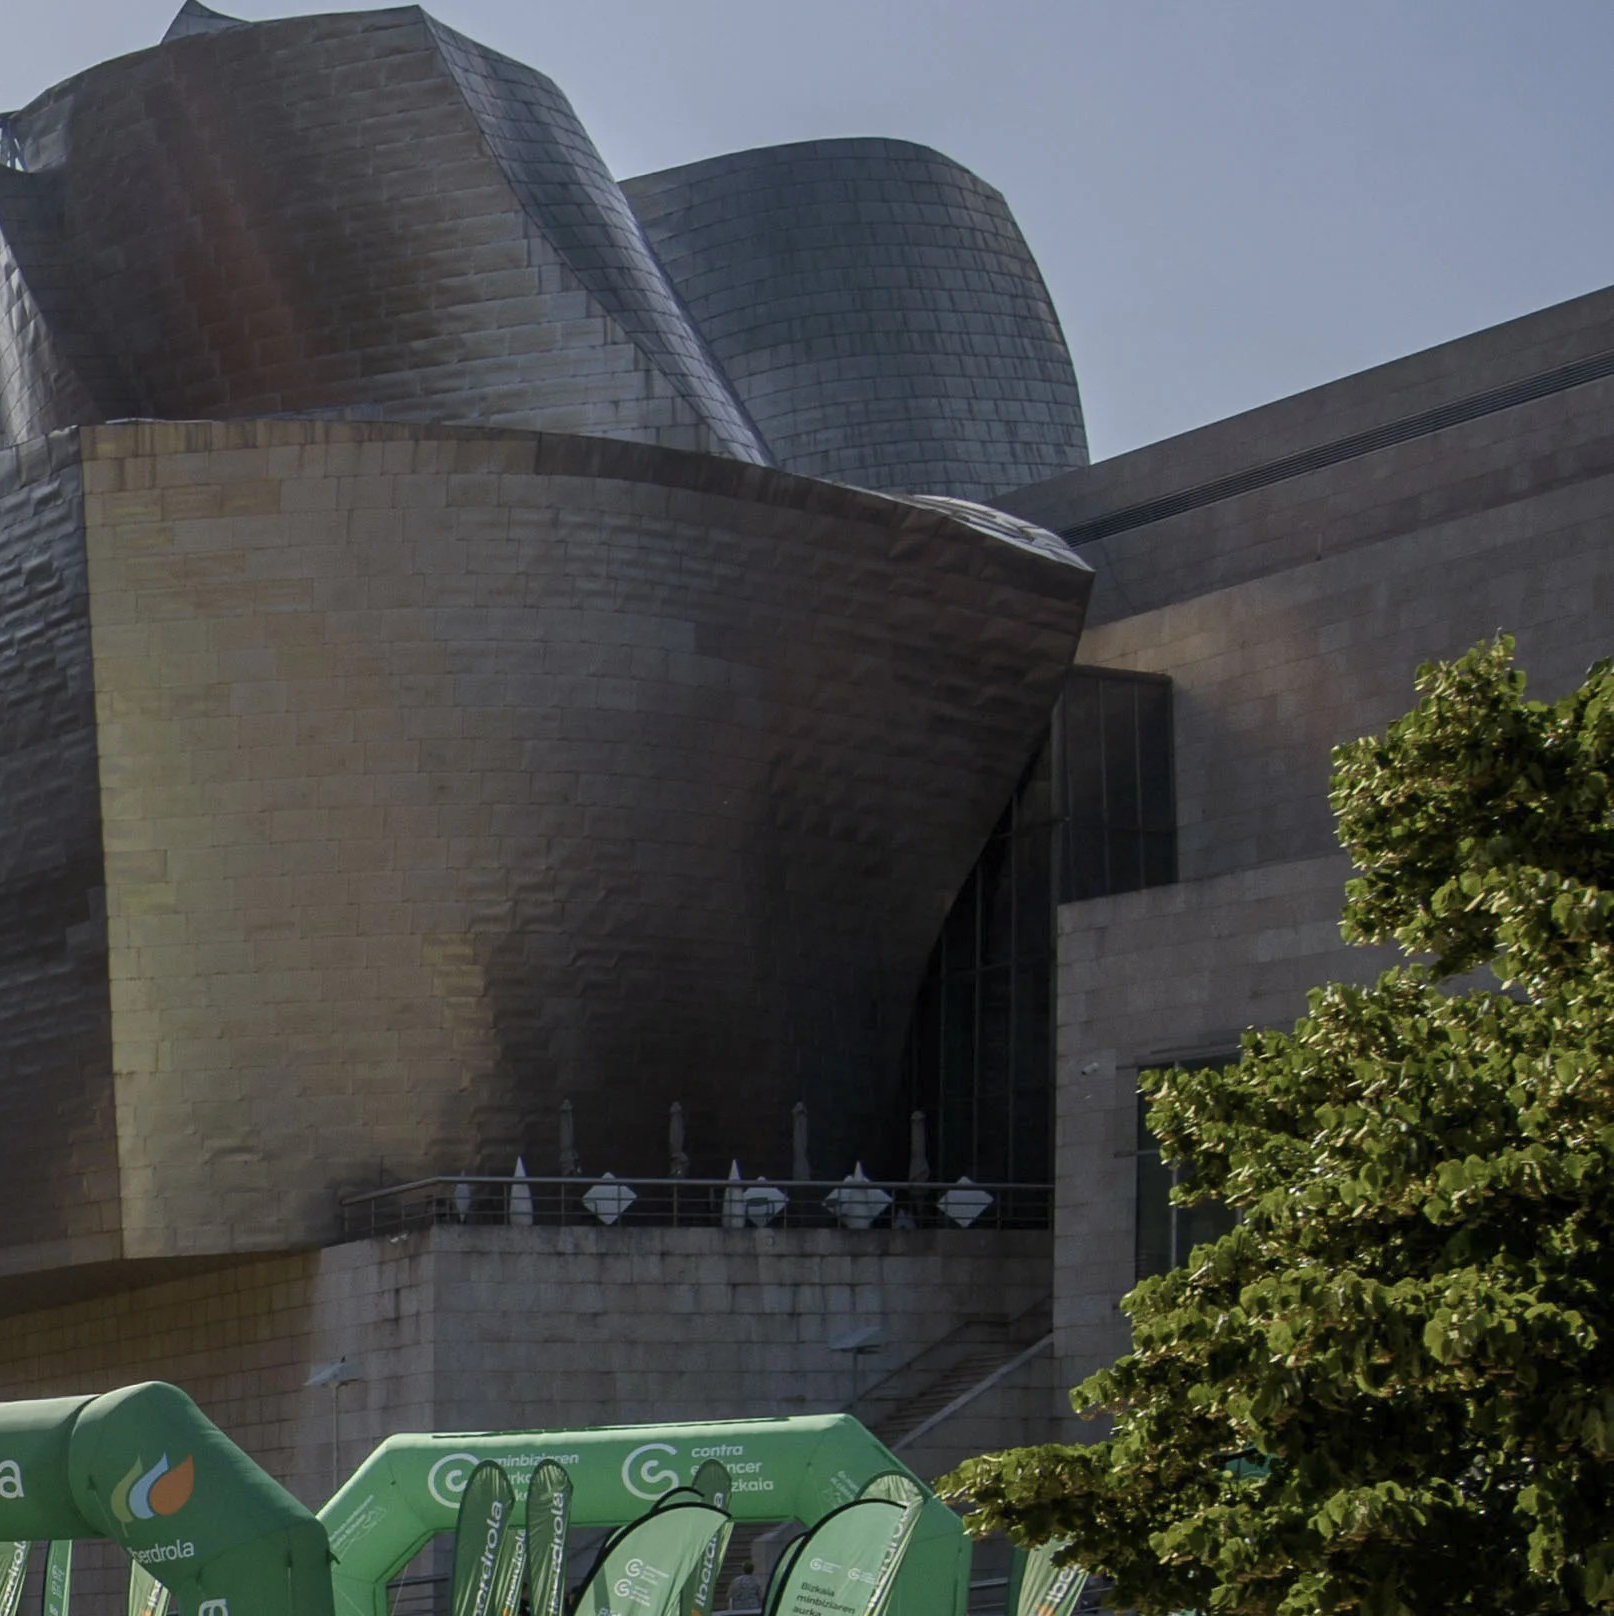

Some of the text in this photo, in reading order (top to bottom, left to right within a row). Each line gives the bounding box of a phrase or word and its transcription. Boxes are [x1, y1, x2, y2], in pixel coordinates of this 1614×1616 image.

[691, 1444, 743, 1458] contra
[725, 1461, 763, 1474] ncer
[731, 1476, 774, 1492] zkaia
[127, 1539, 194, 1563] berdrola
[801, 1582, 835, 1597] Bizkaia
[796, 1594, 856, 1615] minbiziaren
